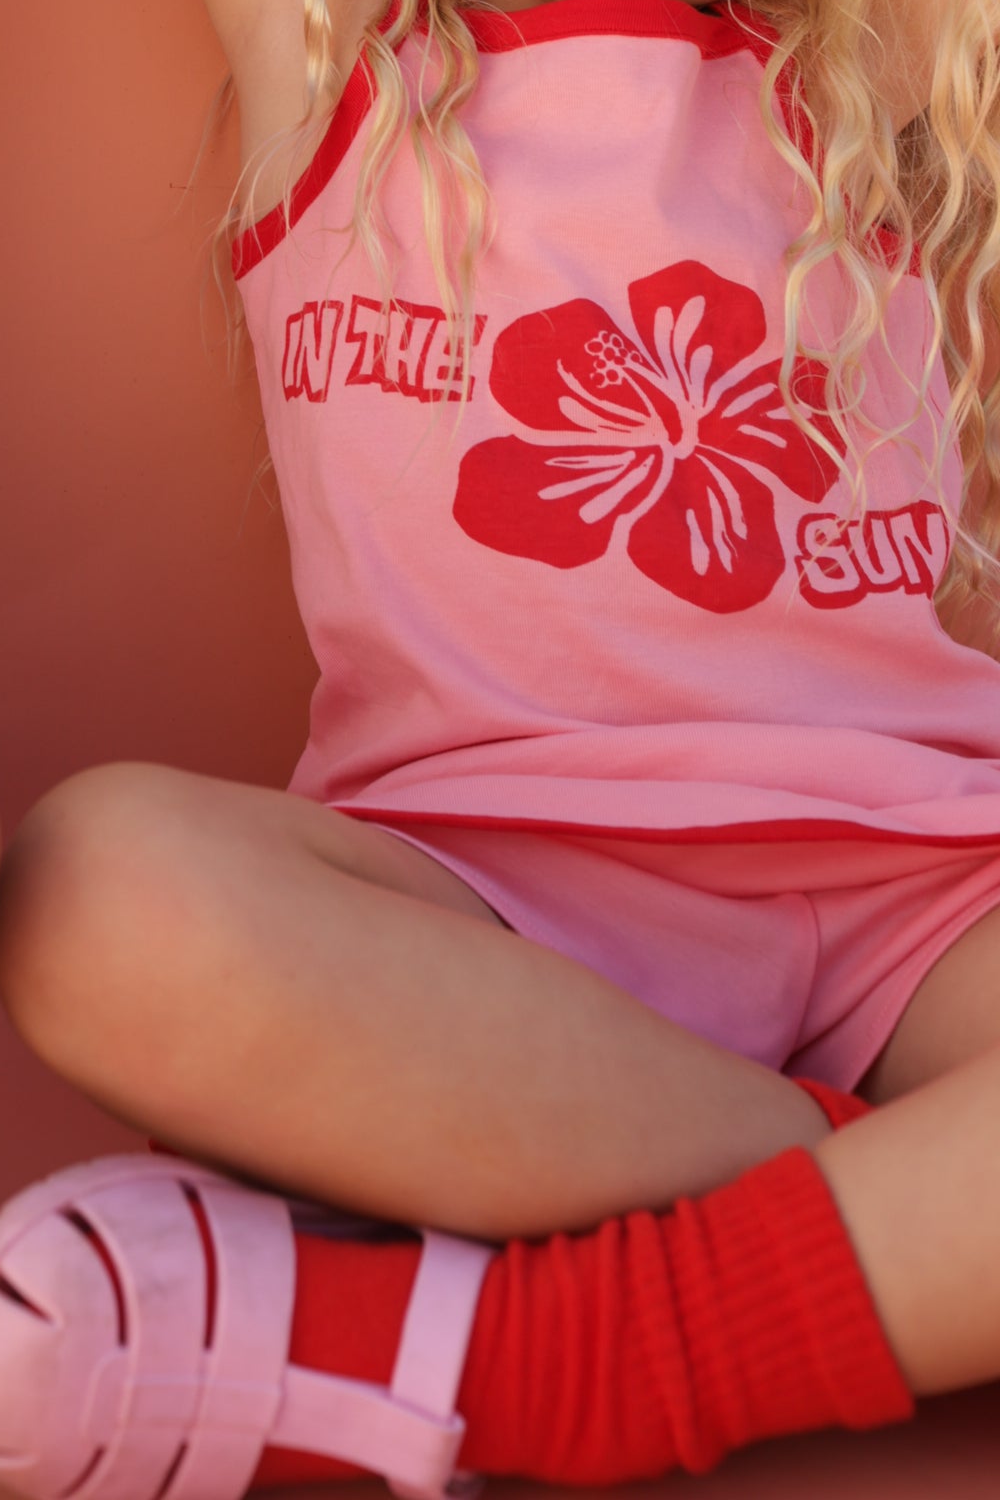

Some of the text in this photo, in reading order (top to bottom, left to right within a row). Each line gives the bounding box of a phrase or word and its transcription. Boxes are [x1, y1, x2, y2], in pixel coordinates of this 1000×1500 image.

[282, 295, 488, 403] IN THE
[794, 500, 950, 610] SUN
